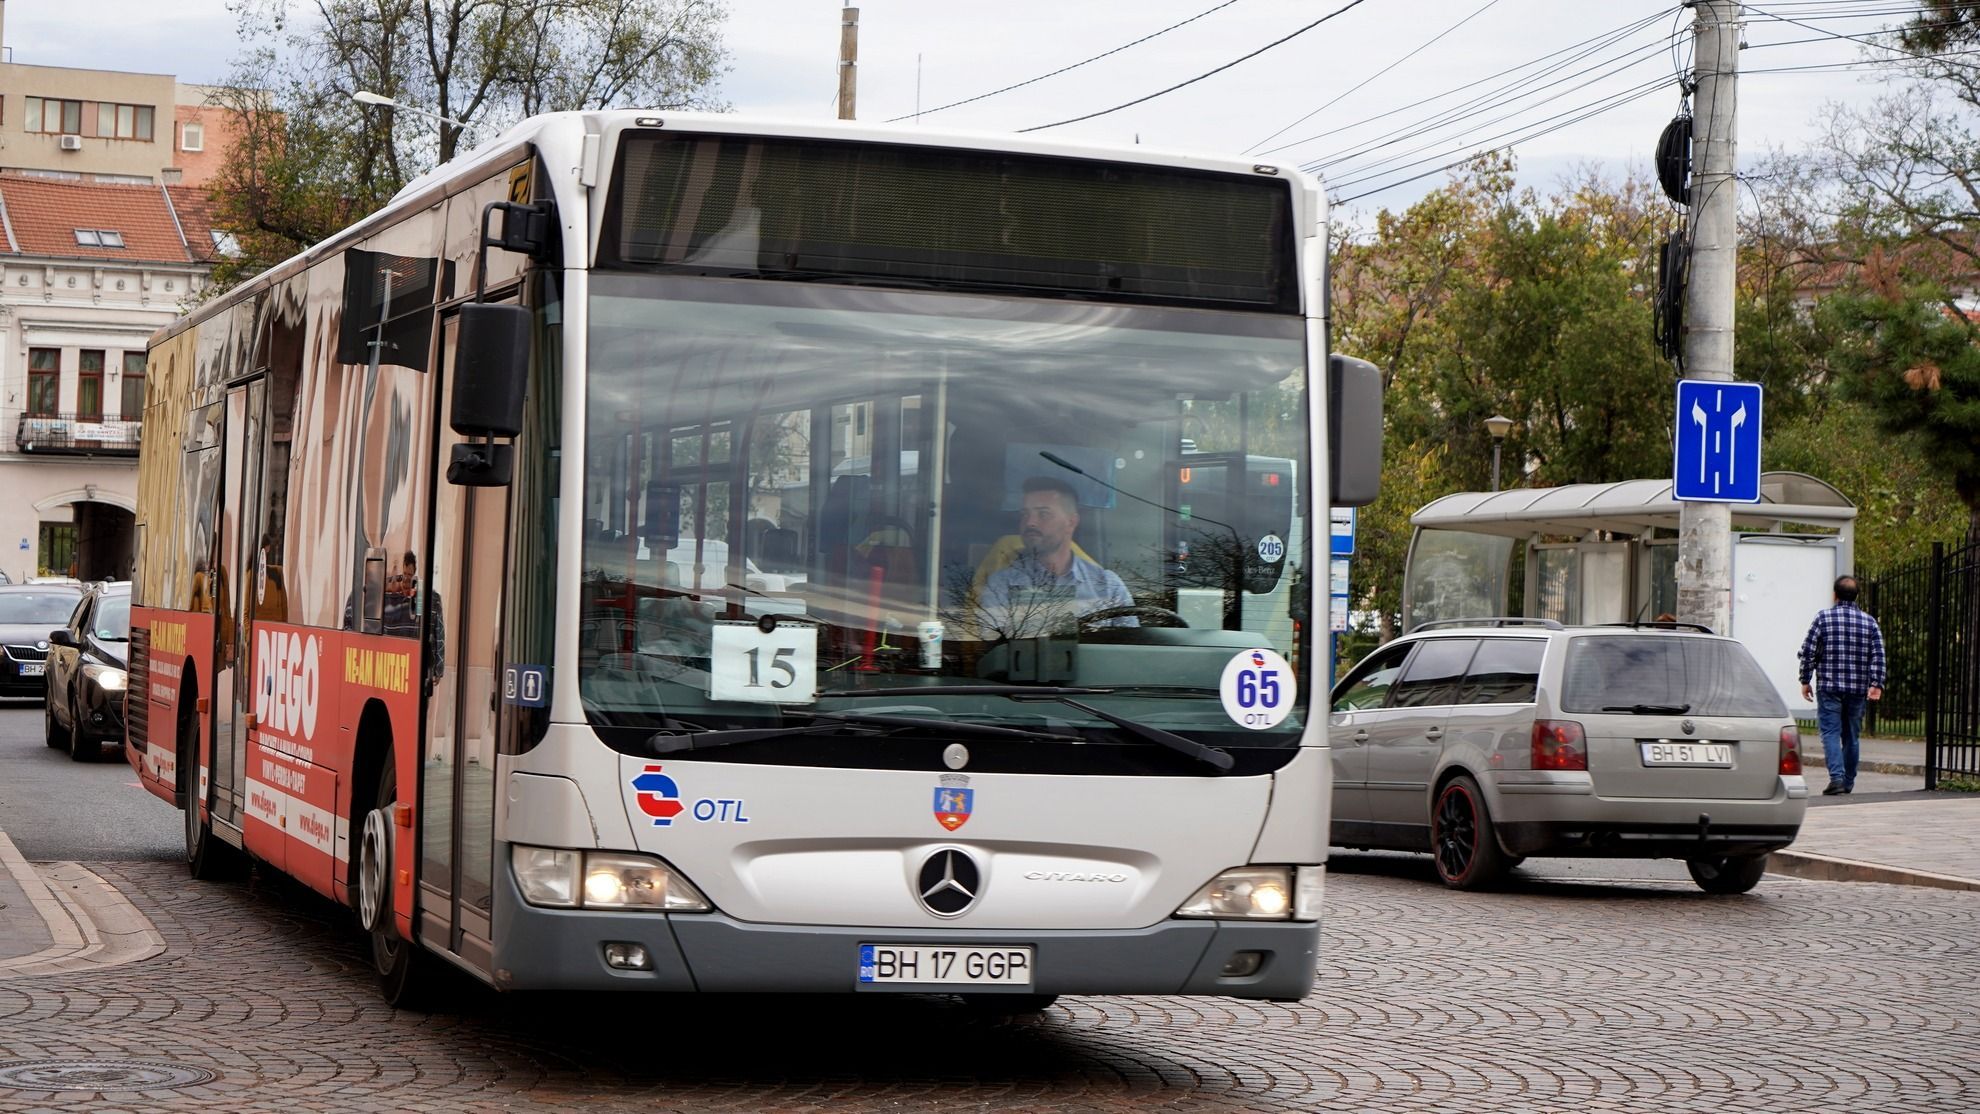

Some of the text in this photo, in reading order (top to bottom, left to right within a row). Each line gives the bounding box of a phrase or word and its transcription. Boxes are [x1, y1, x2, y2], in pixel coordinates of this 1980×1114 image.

[1260, 541, 1282, 556] 205
[24, 665, 36, 673] BH
[345, 647, 411, 694] NE-AM MUTAT!
[743, 646, 796, 689] 15
[256, 629, 319, 741] DIEGO
[1238, 669, 1280, 708] 65
[1244, 713, 1272, 725] OTL
[1652, 746, 1675, 761] BH
[1680, 746, 1695, 761] 51
[693, 799, 750, 823] OTL
[1023, 871, 1128, 883] CITARO
[878, 950, 918, 979] BH
[931, 951, 957, 979] 17
[966, 951, 1027, 980] GGP
